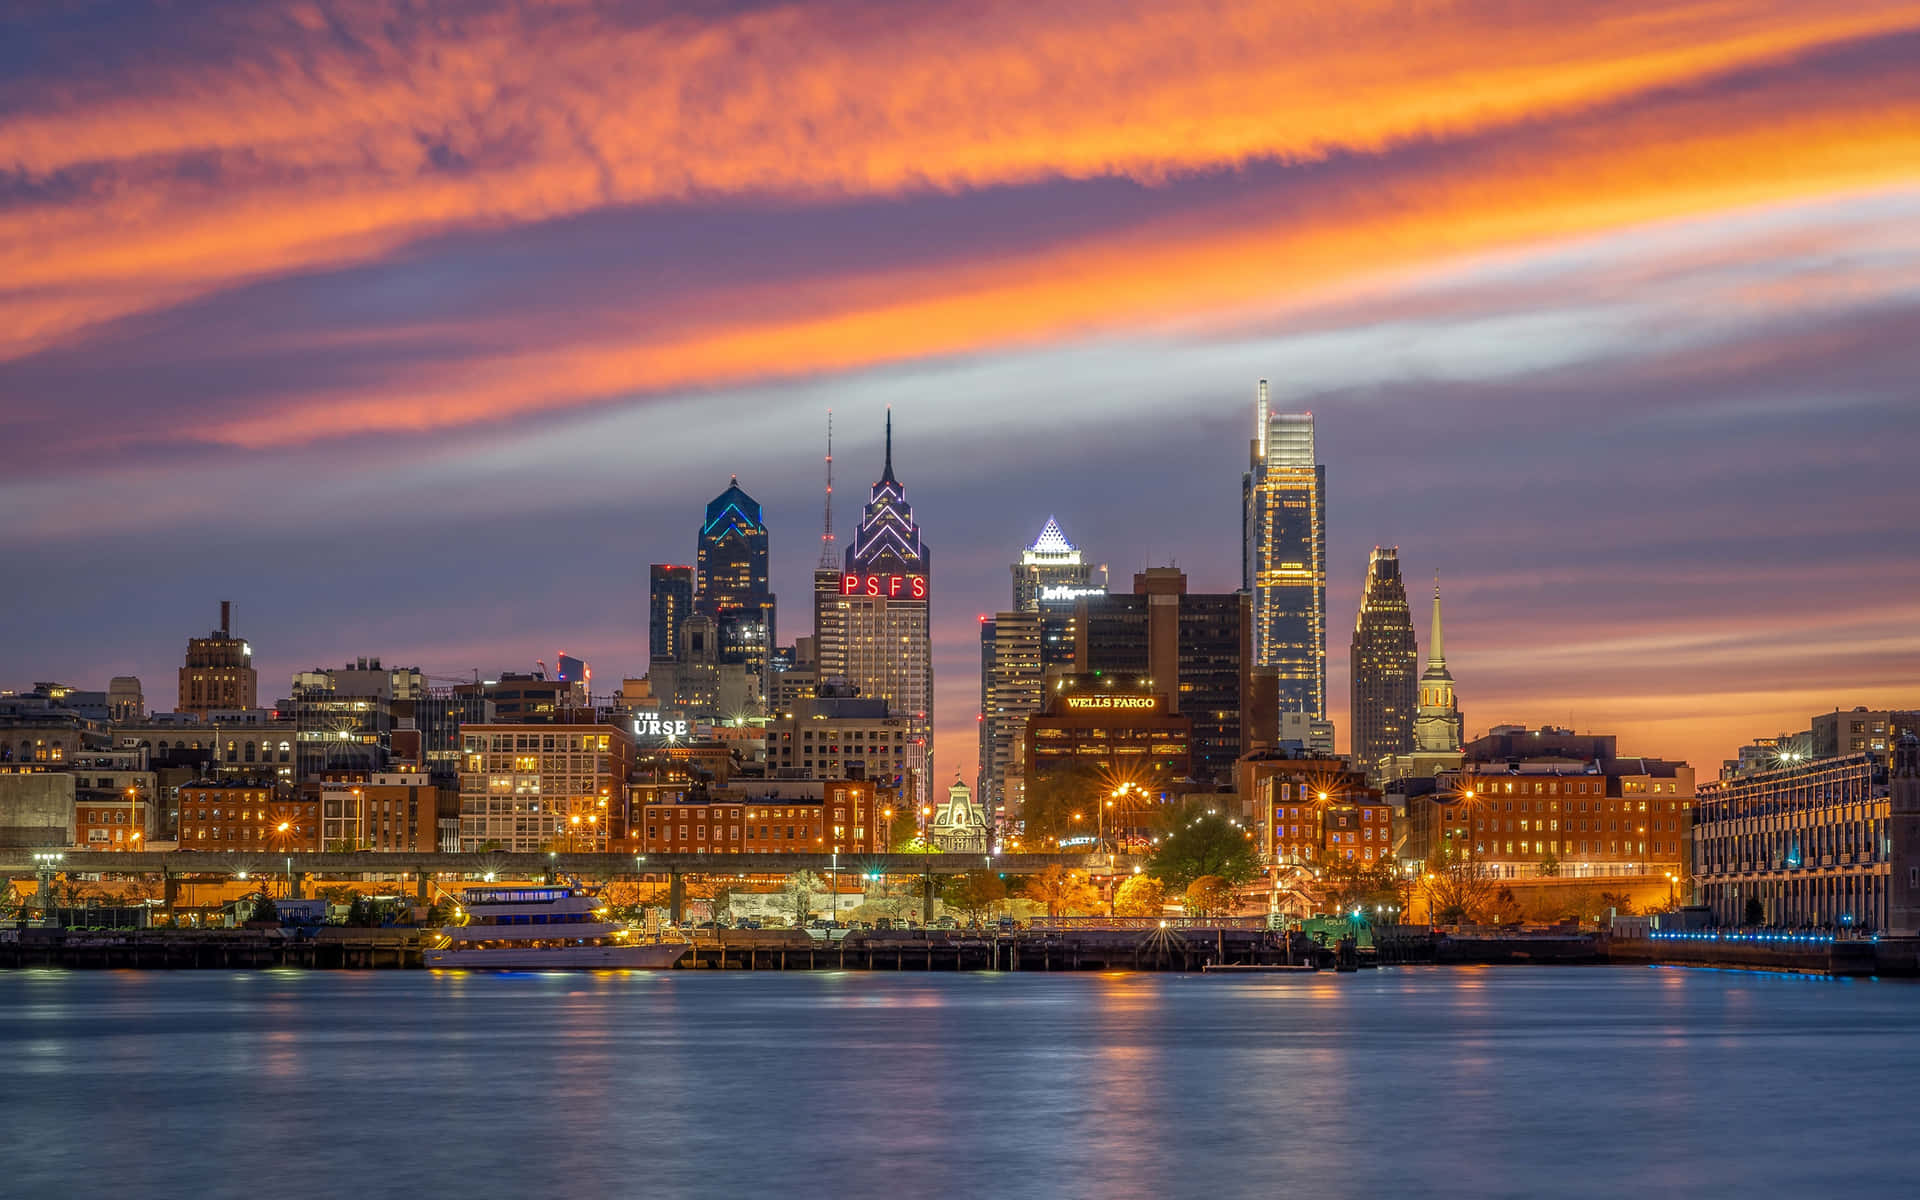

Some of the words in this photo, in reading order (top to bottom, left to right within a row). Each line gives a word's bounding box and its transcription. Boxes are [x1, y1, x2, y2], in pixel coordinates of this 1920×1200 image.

[843, 574, 926, 598] PSFS
[1067, 697, 1111, 708] WELLS
[1113, 697, 1155, 708] FARGO
[637, 712, 659, 720] THE
[633, 720, 687, 735] URSE
